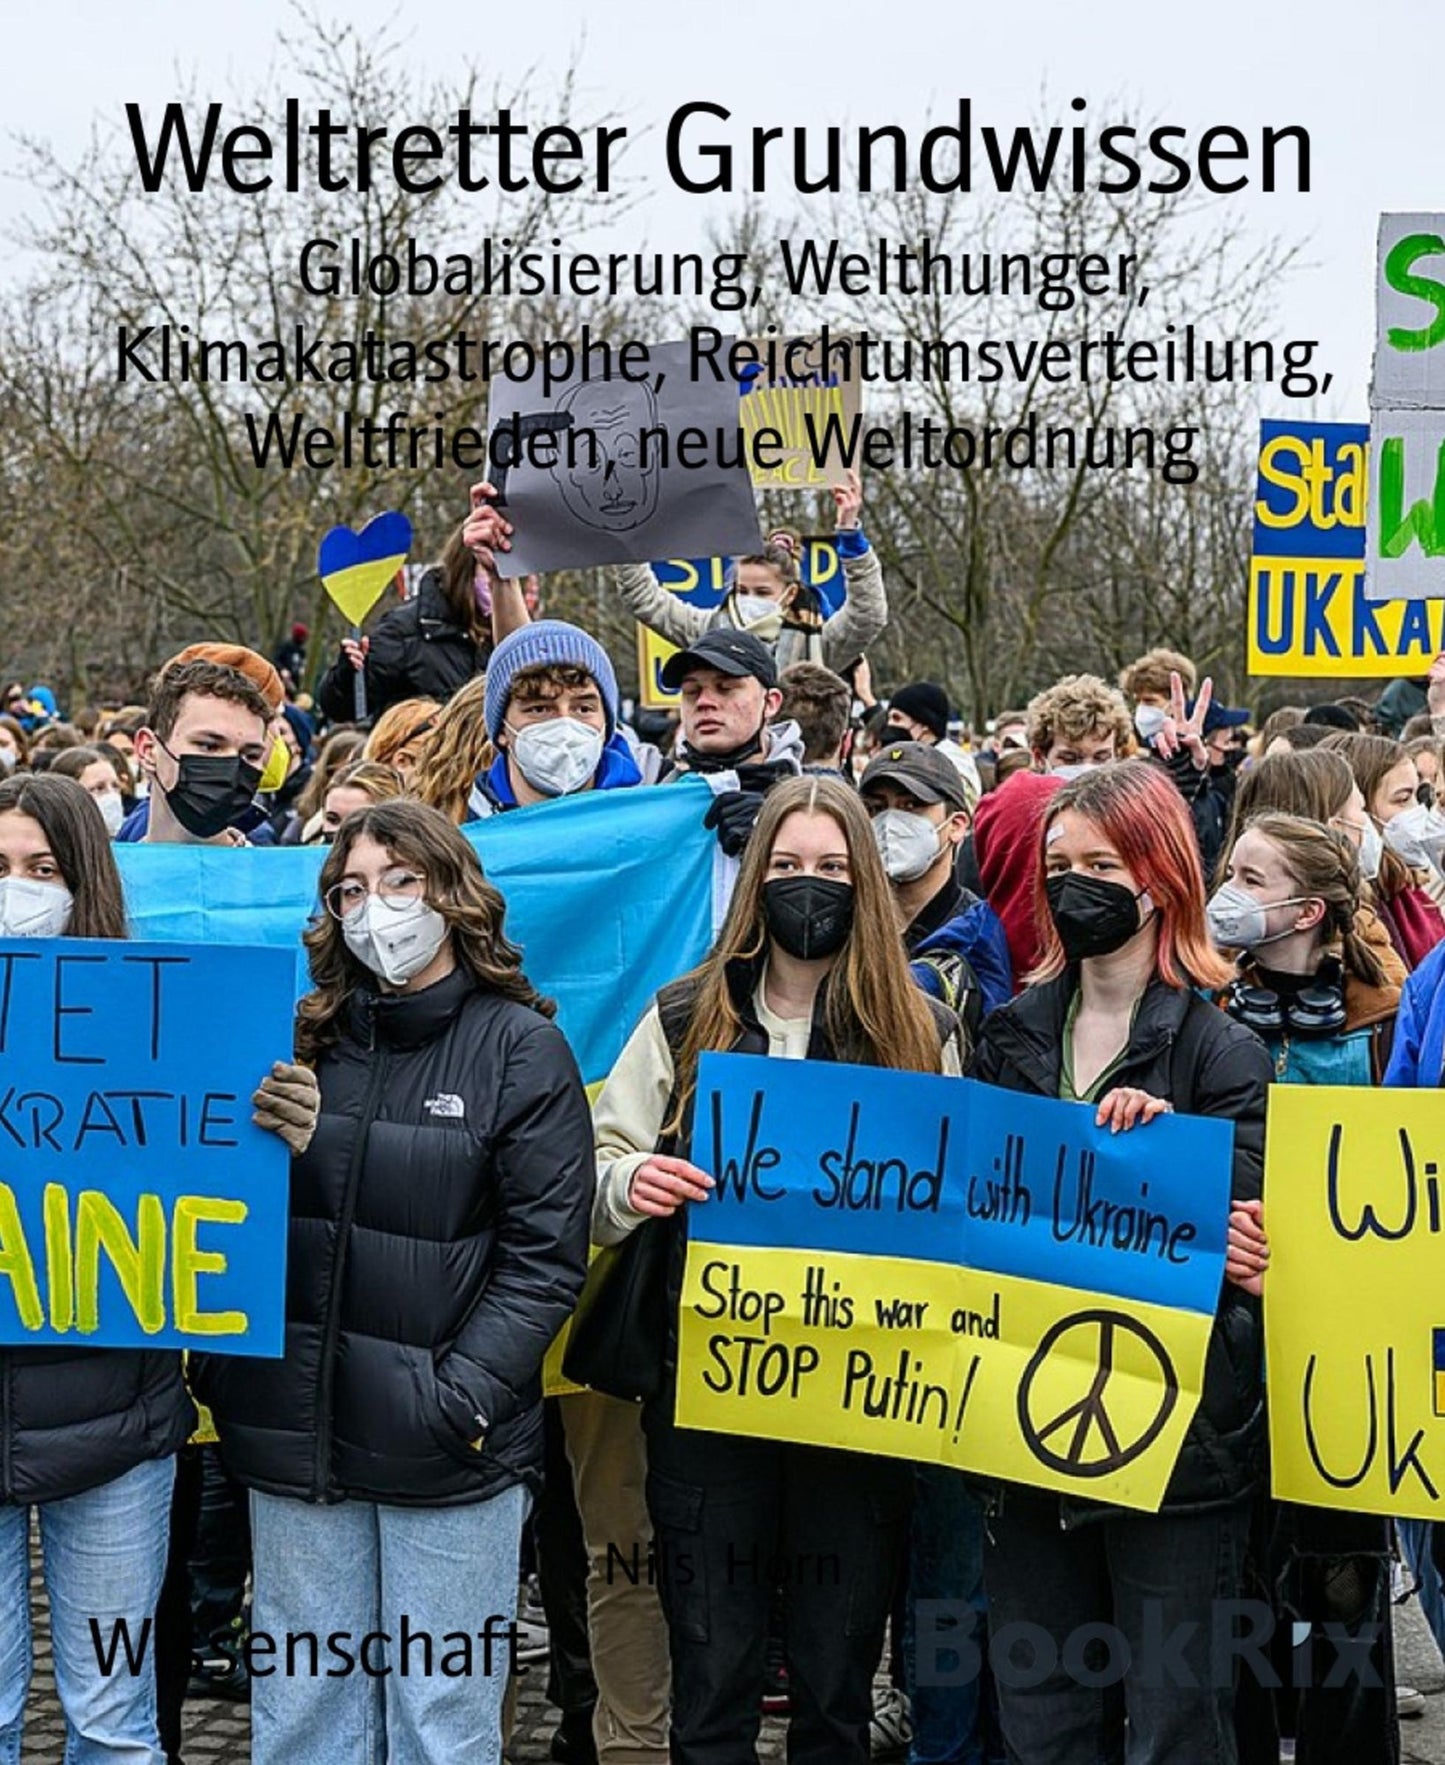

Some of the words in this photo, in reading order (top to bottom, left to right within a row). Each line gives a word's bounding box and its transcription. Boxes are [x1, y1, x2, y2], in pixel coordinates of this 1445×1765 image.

[711, 1090, 786, 1202] We
[812, 1101, 949, 1214] stand
[966, 1134, 1031, 1227] with
[1051, 1145, 1197, 1264] Ukraine
[693, 1261, 785, 1336] Stop
[802, 1266, 854, 1330] this
[875, 1299, 928, 1331] war
[950, 1293, 1000, 1341] and
[702, 1334, 819, 1399] STOP
[841, 1350, 982, 1445] Putin!
